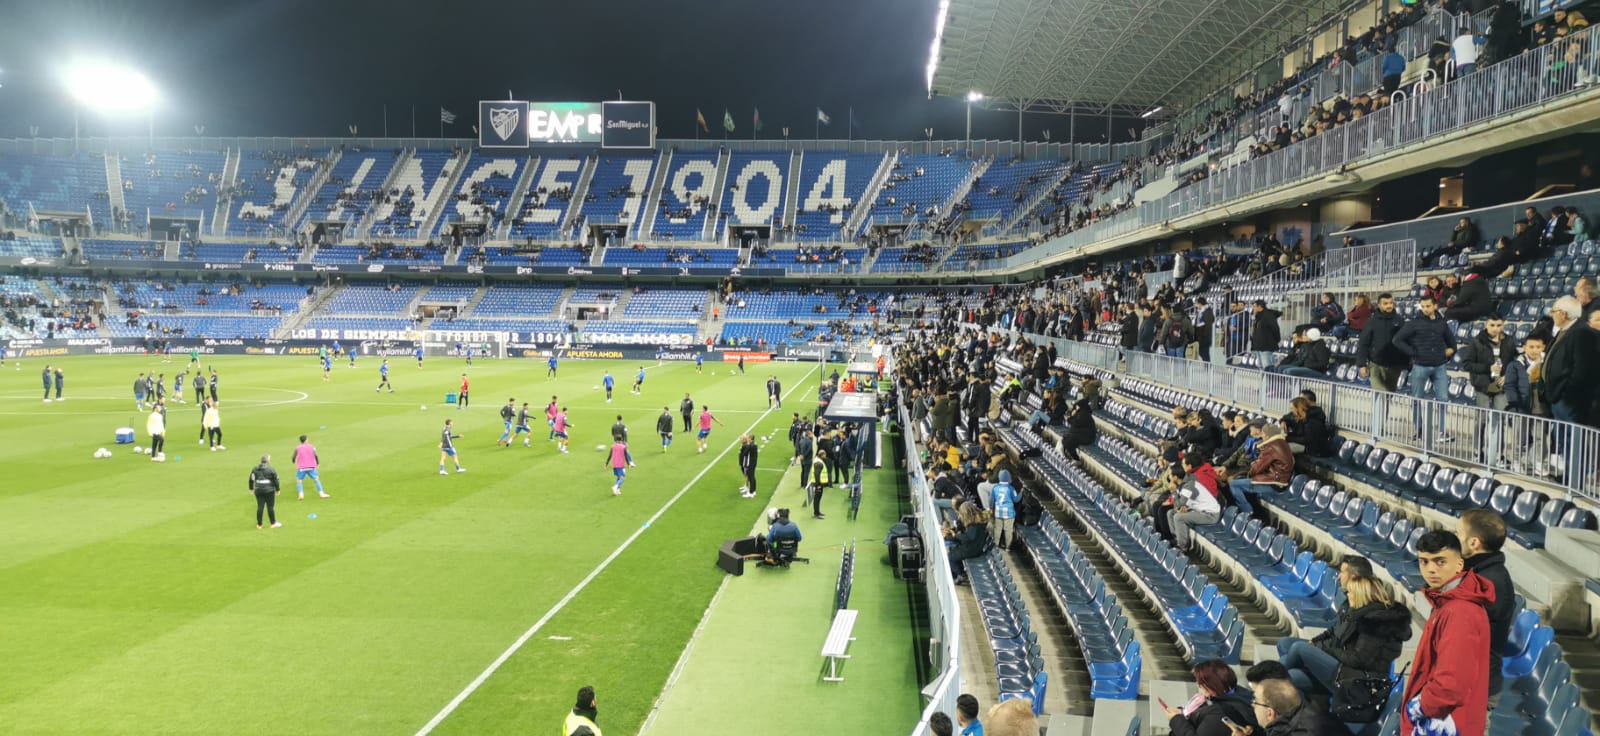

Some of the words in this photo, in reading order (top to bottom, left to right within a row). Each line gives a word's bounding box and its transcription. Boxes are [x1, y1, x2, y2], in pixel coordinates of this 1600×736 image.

[617, 159, 852, 224] 1904
[291, 328, 316, 339] LOS
[321, 329, 339, 340] DE
[344, 329, 407, 340] SIEMPRE
